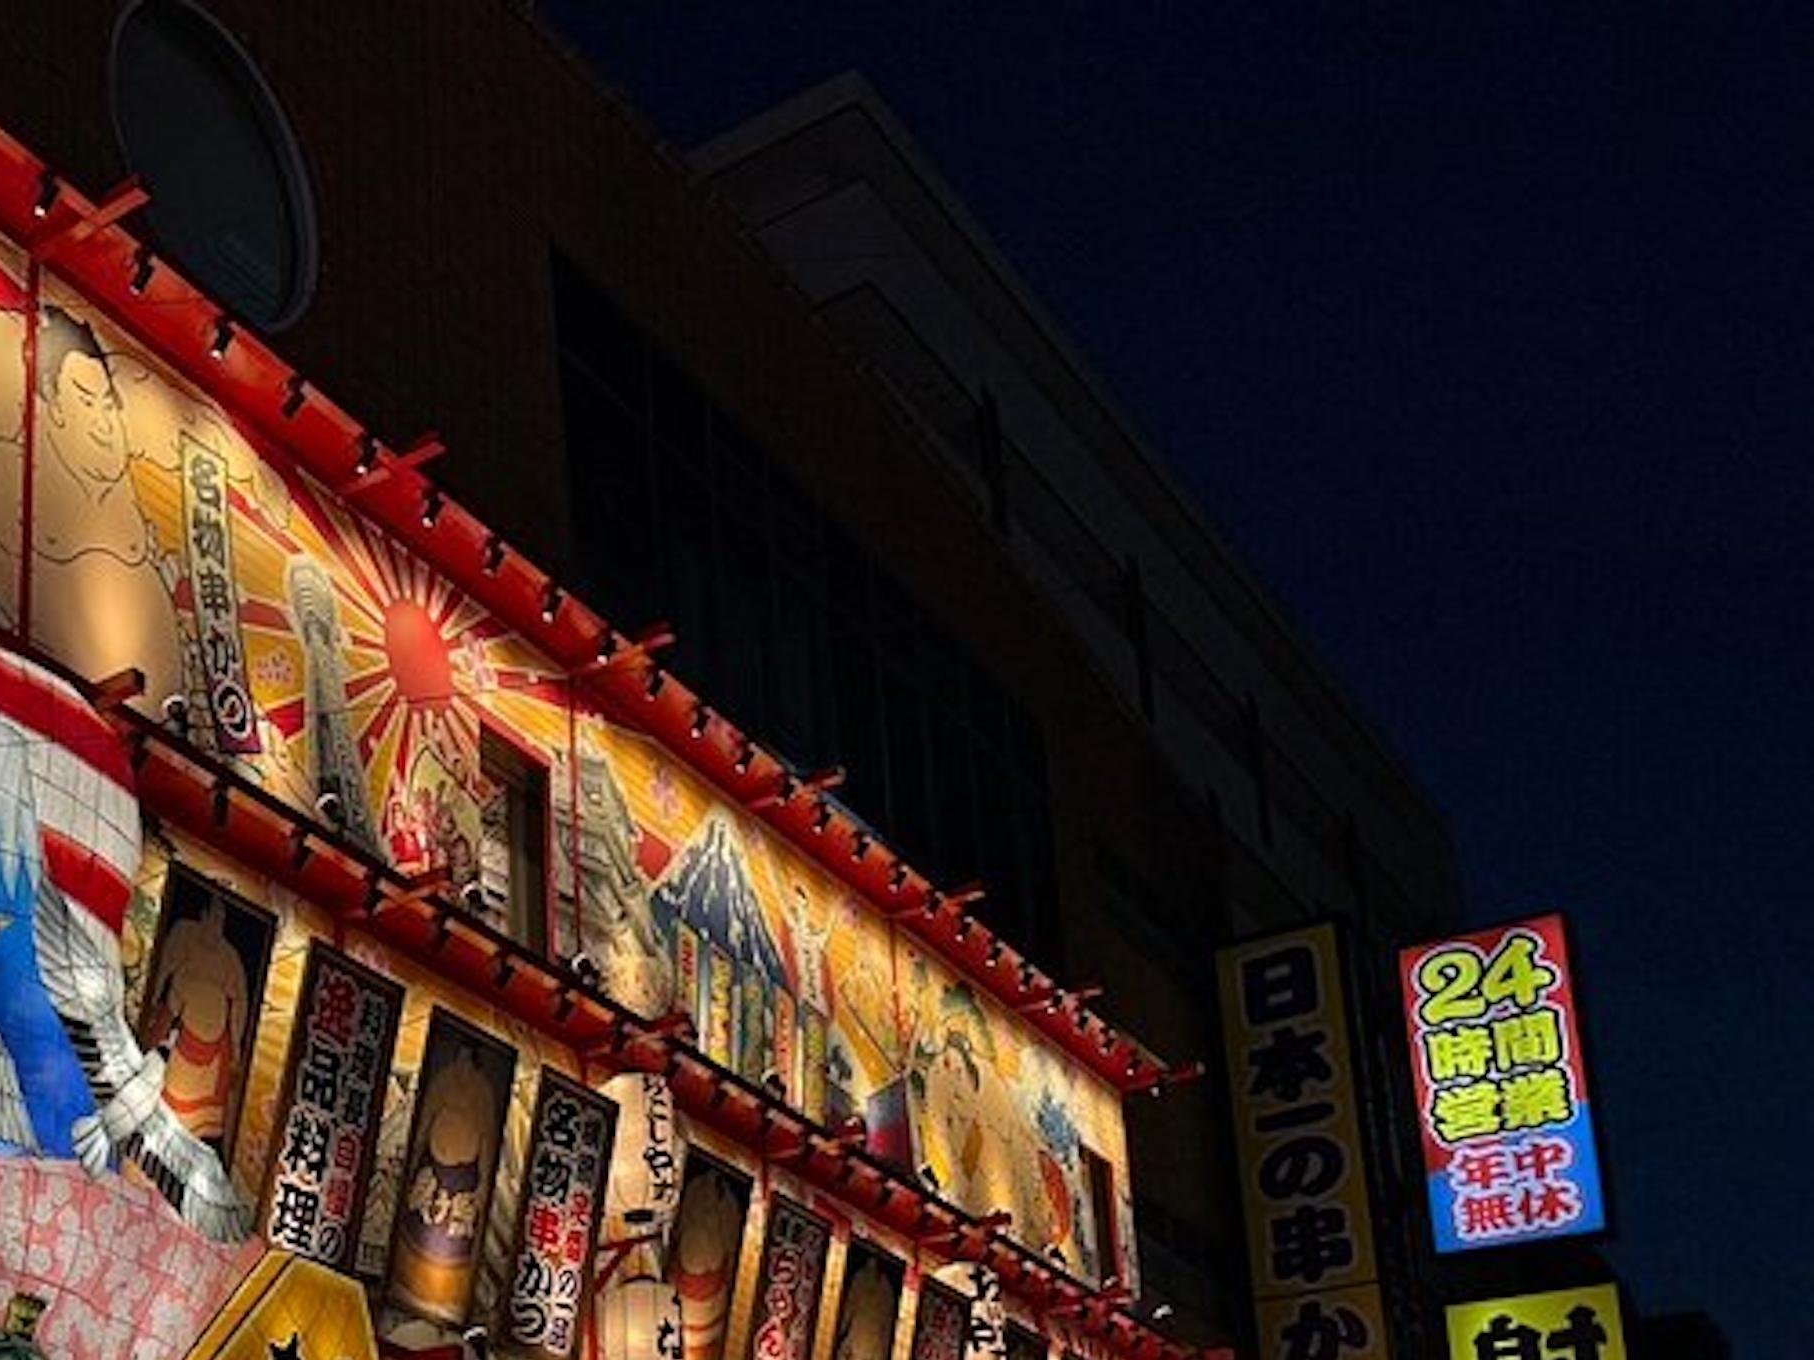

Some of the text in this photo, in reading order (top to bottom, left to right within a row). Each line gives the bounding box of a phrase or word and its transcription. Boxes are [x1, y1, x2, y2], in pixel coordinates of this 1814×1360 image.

[1420, 934, 1555, 1024] 24
[1428, 1008, 1560, 1080] 時間
[1434, 1072, 1571, 1142] 営業
[1458, 1143, 1569, 1188] 年中
[512, 1098, 582, 1346] 名物串かつ
[1460, 1186, 1578, 1233] 無休
